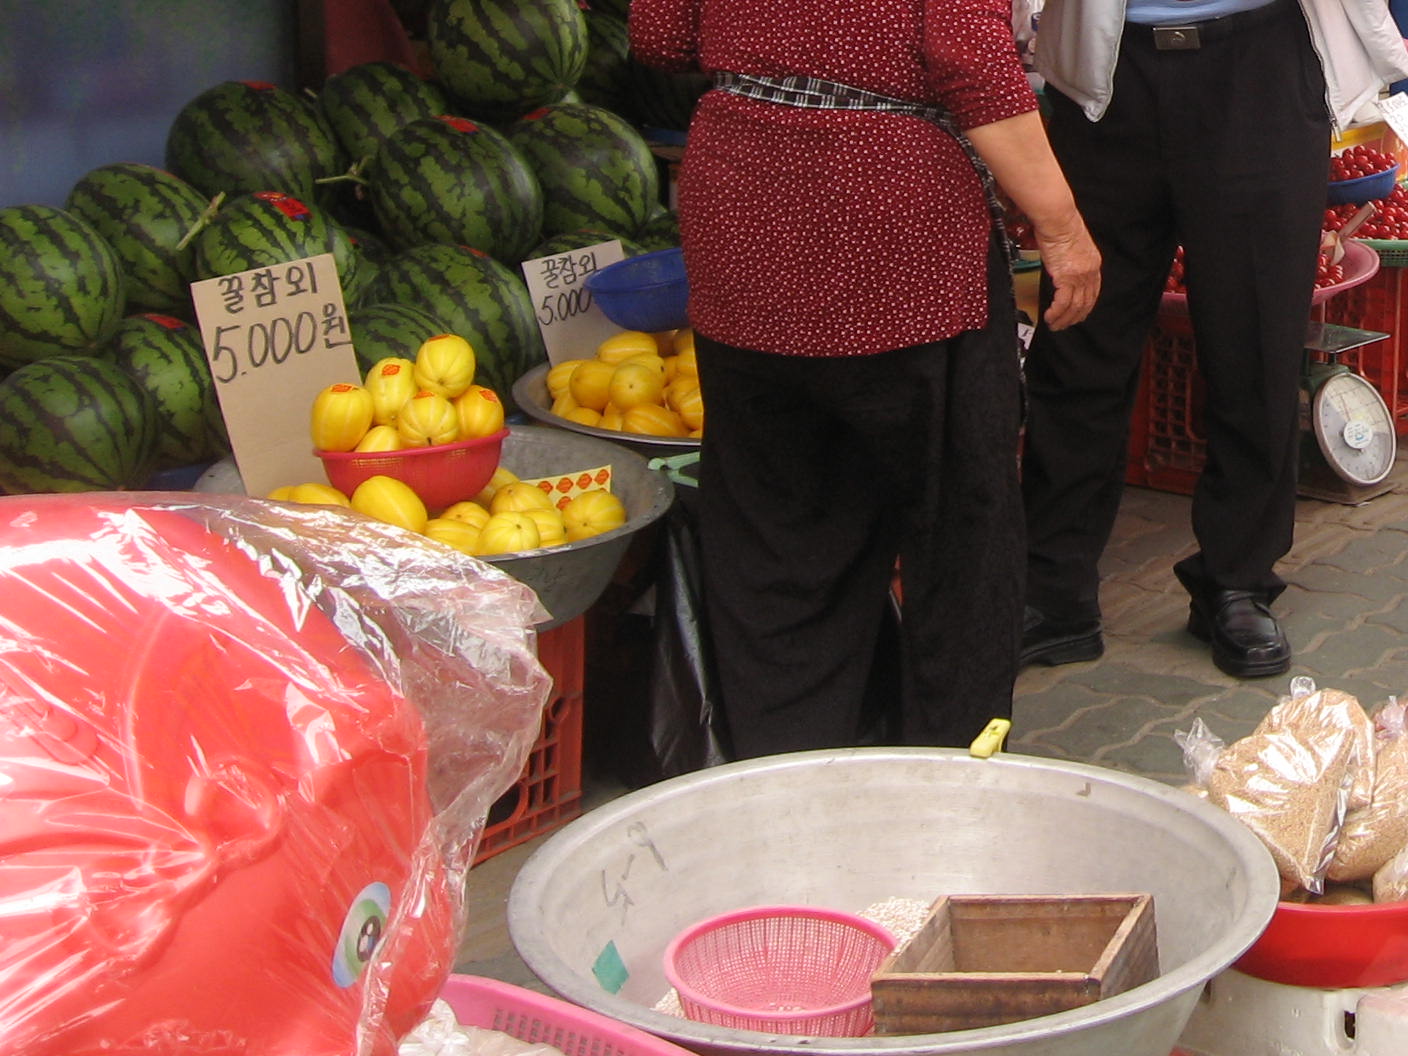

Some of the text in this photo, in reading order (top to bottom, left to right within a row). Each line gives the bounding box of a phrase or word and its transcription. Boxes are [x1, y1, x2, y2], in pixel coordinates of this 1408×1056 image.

[218, 262, 318, 314] 꿀참외
[540, 252, 597, 289] 꿀참외
[213, 303, 352, 384] 5.000원
